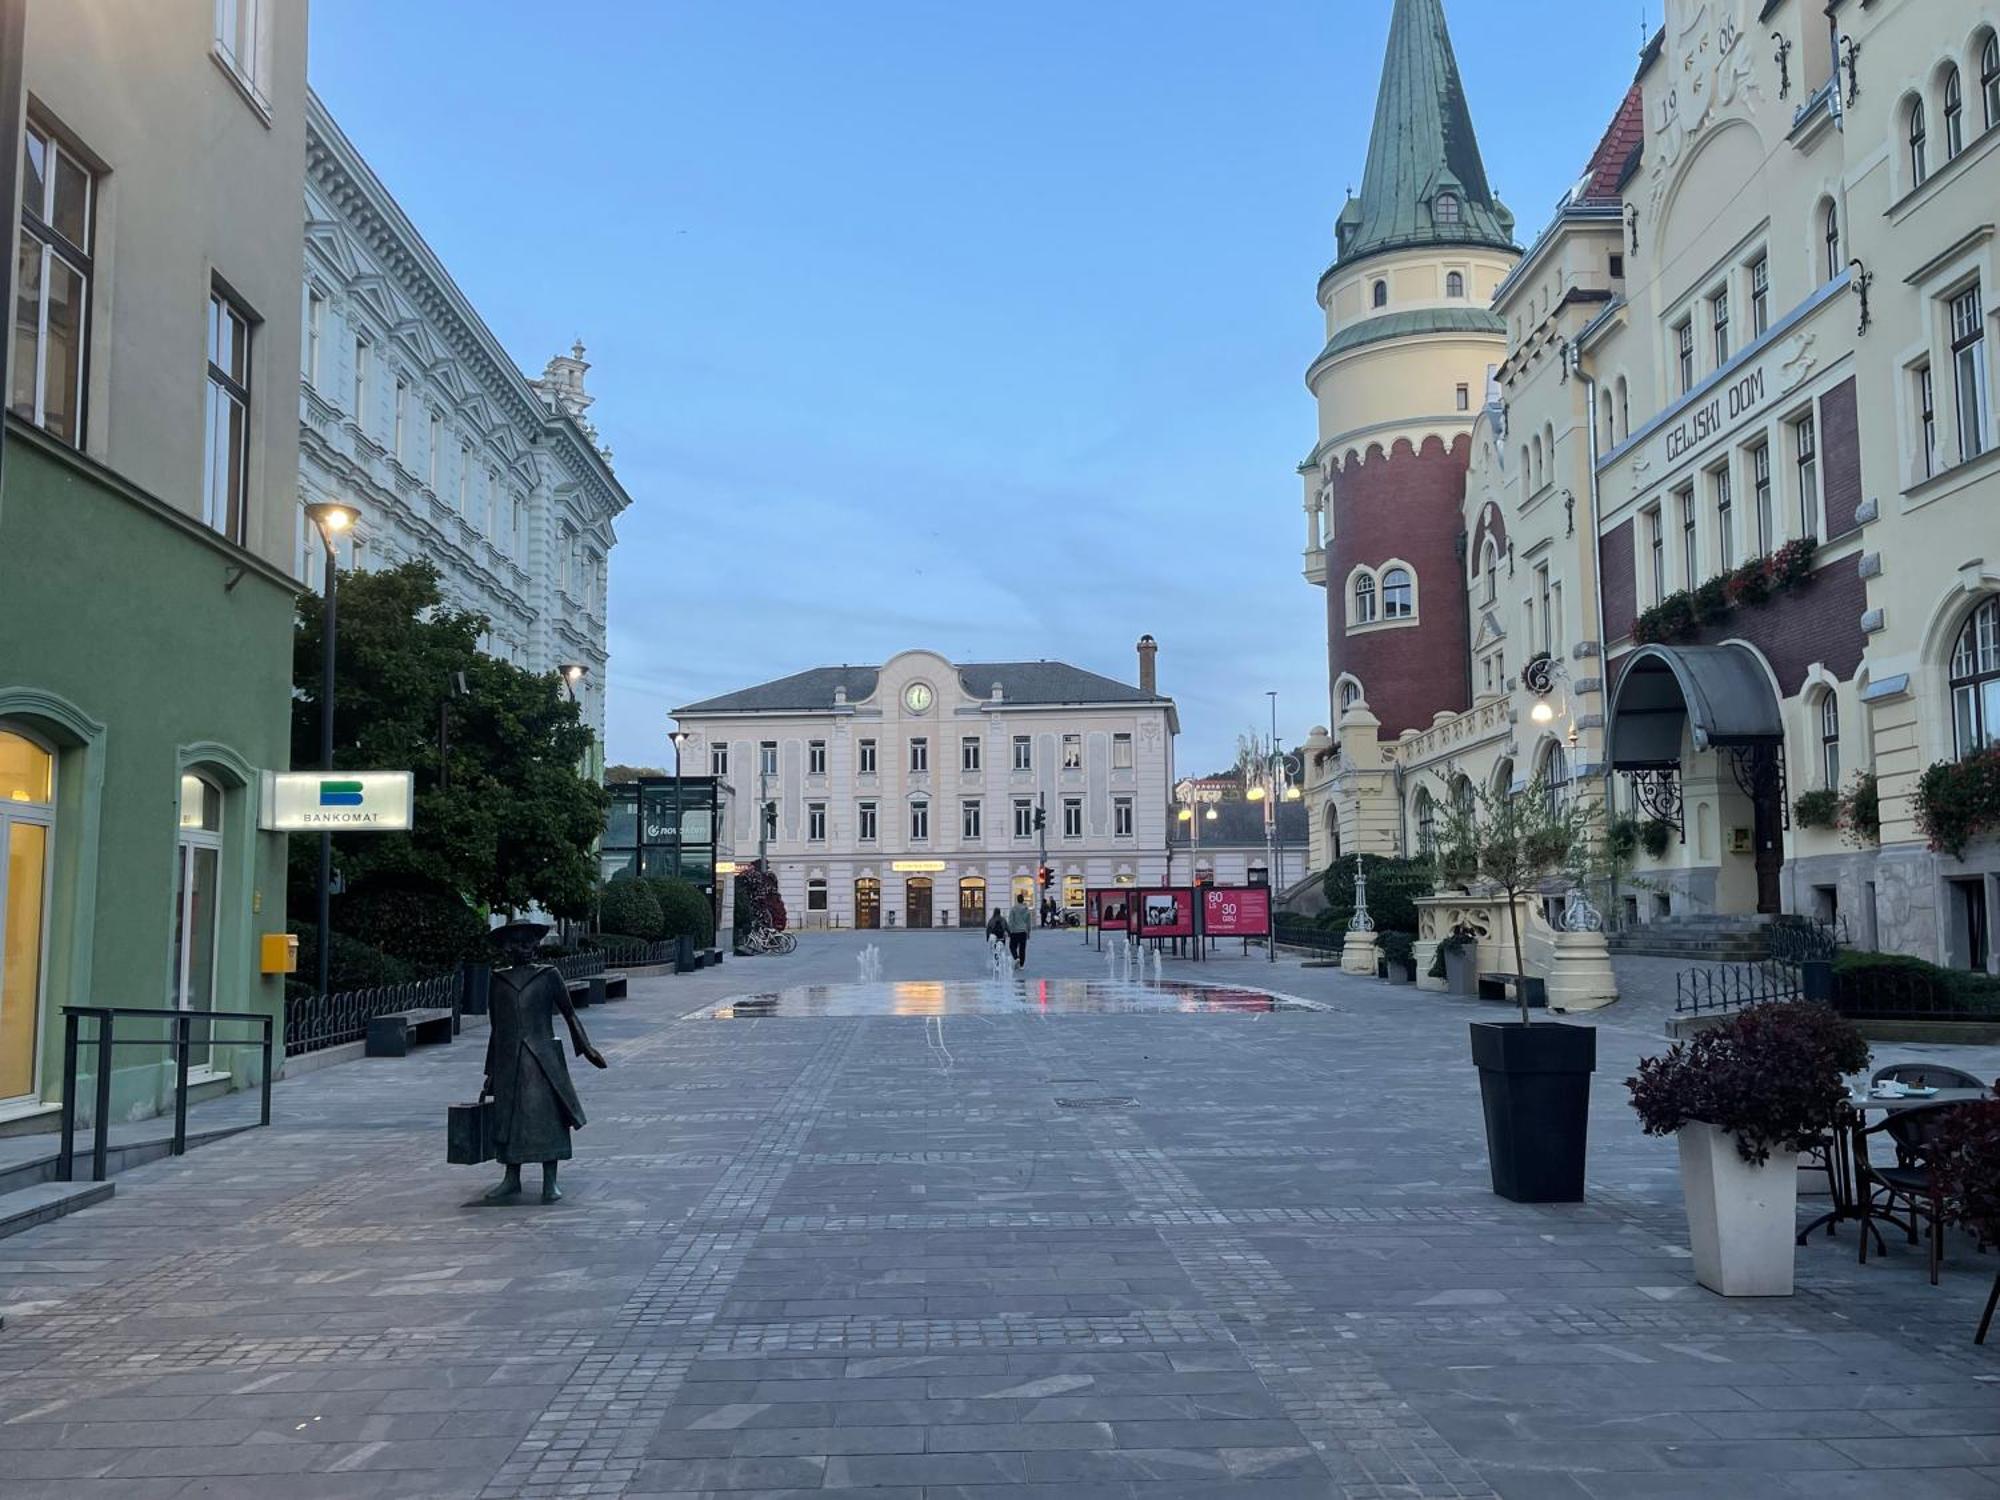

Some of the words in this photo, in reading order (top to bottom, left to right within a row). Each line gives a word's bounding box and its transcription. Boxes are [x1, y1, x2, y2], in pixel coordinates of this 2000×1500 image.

[1663, 88, 1677, 122] 19
[1666, 398, 1720, 462] CELJSKI
[1728, 366, 1764, 419] DOM
[303, 813, 378, 822] BANKOMAT
[1208, 892, 1223, 902] 60
[1222, 904, 1236, 914] 30
